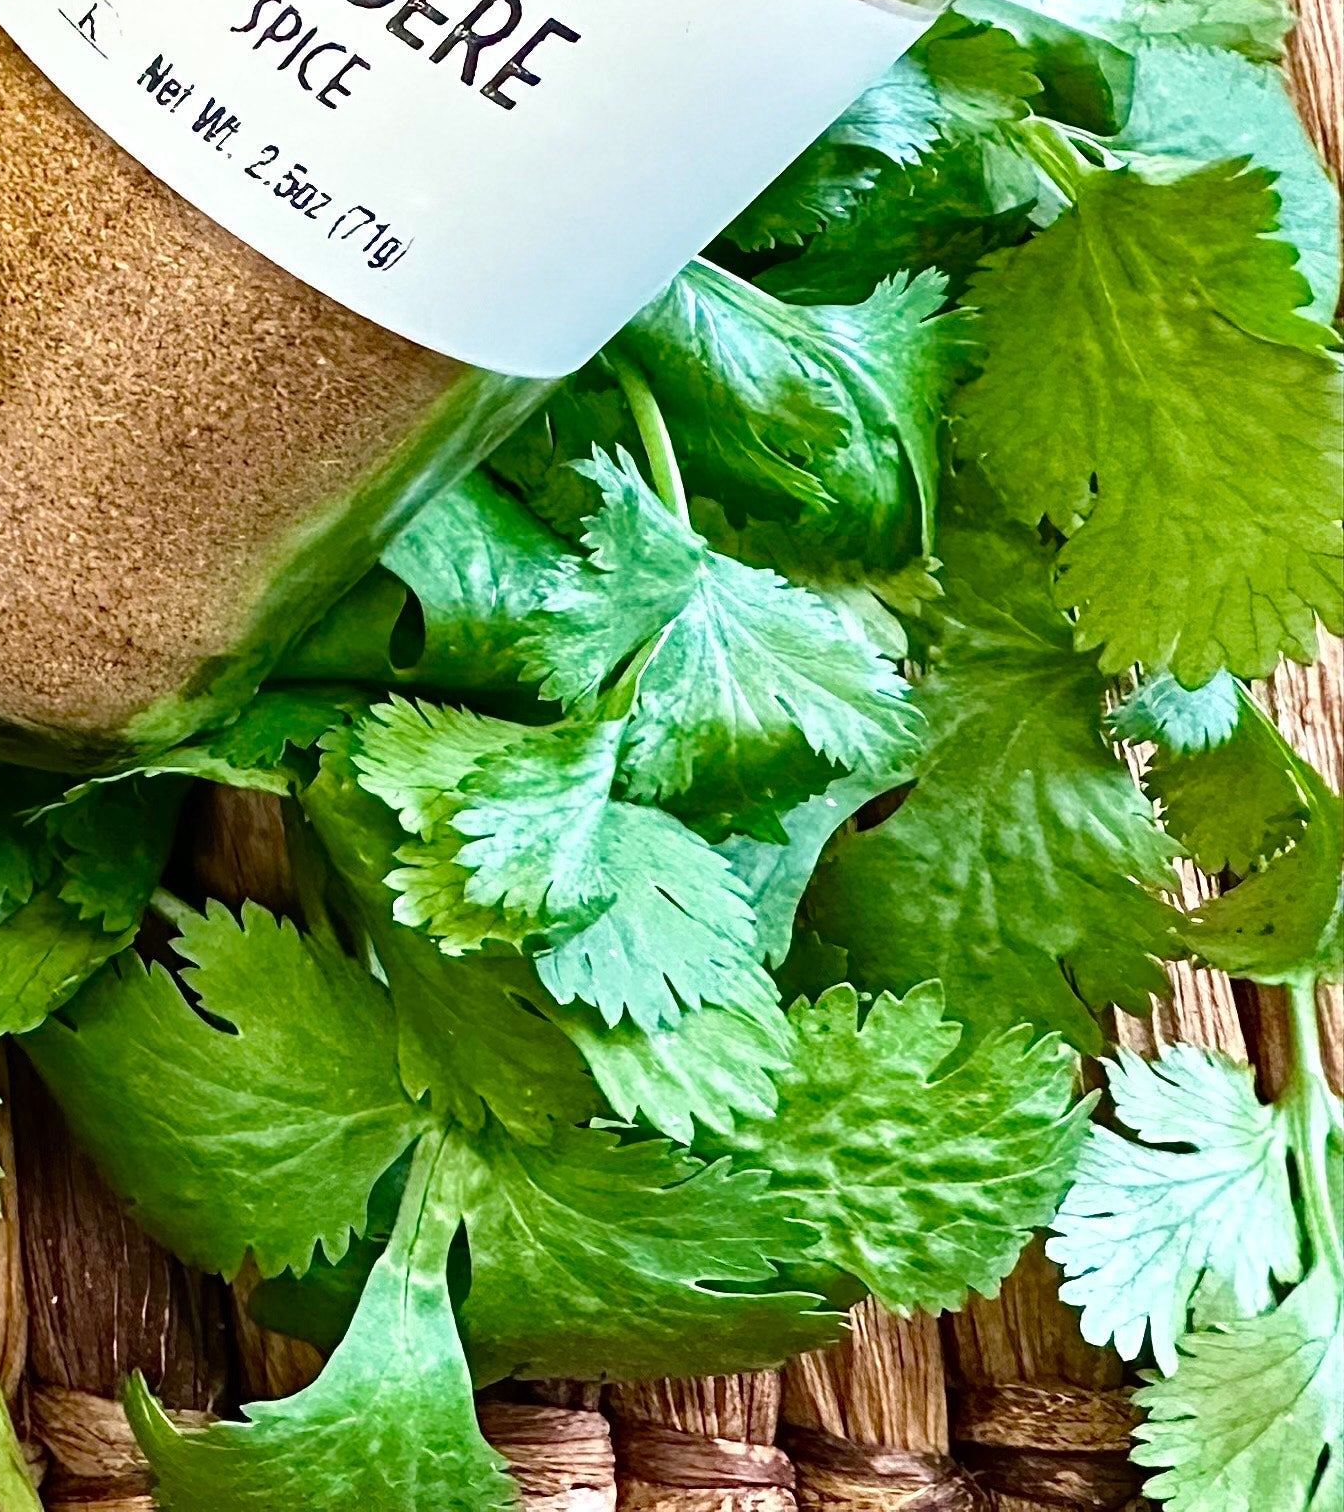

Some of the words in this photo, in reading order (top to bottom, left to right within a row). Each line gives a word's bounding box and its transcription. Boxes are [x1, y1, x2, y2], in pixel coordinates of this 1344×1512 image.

[136, 53, 196, 113] Net
[191, 96, 242, 159] Wt.
[244, 144, 334, 221] 2.5oz
[328, 204, 415, 272] (71g)
